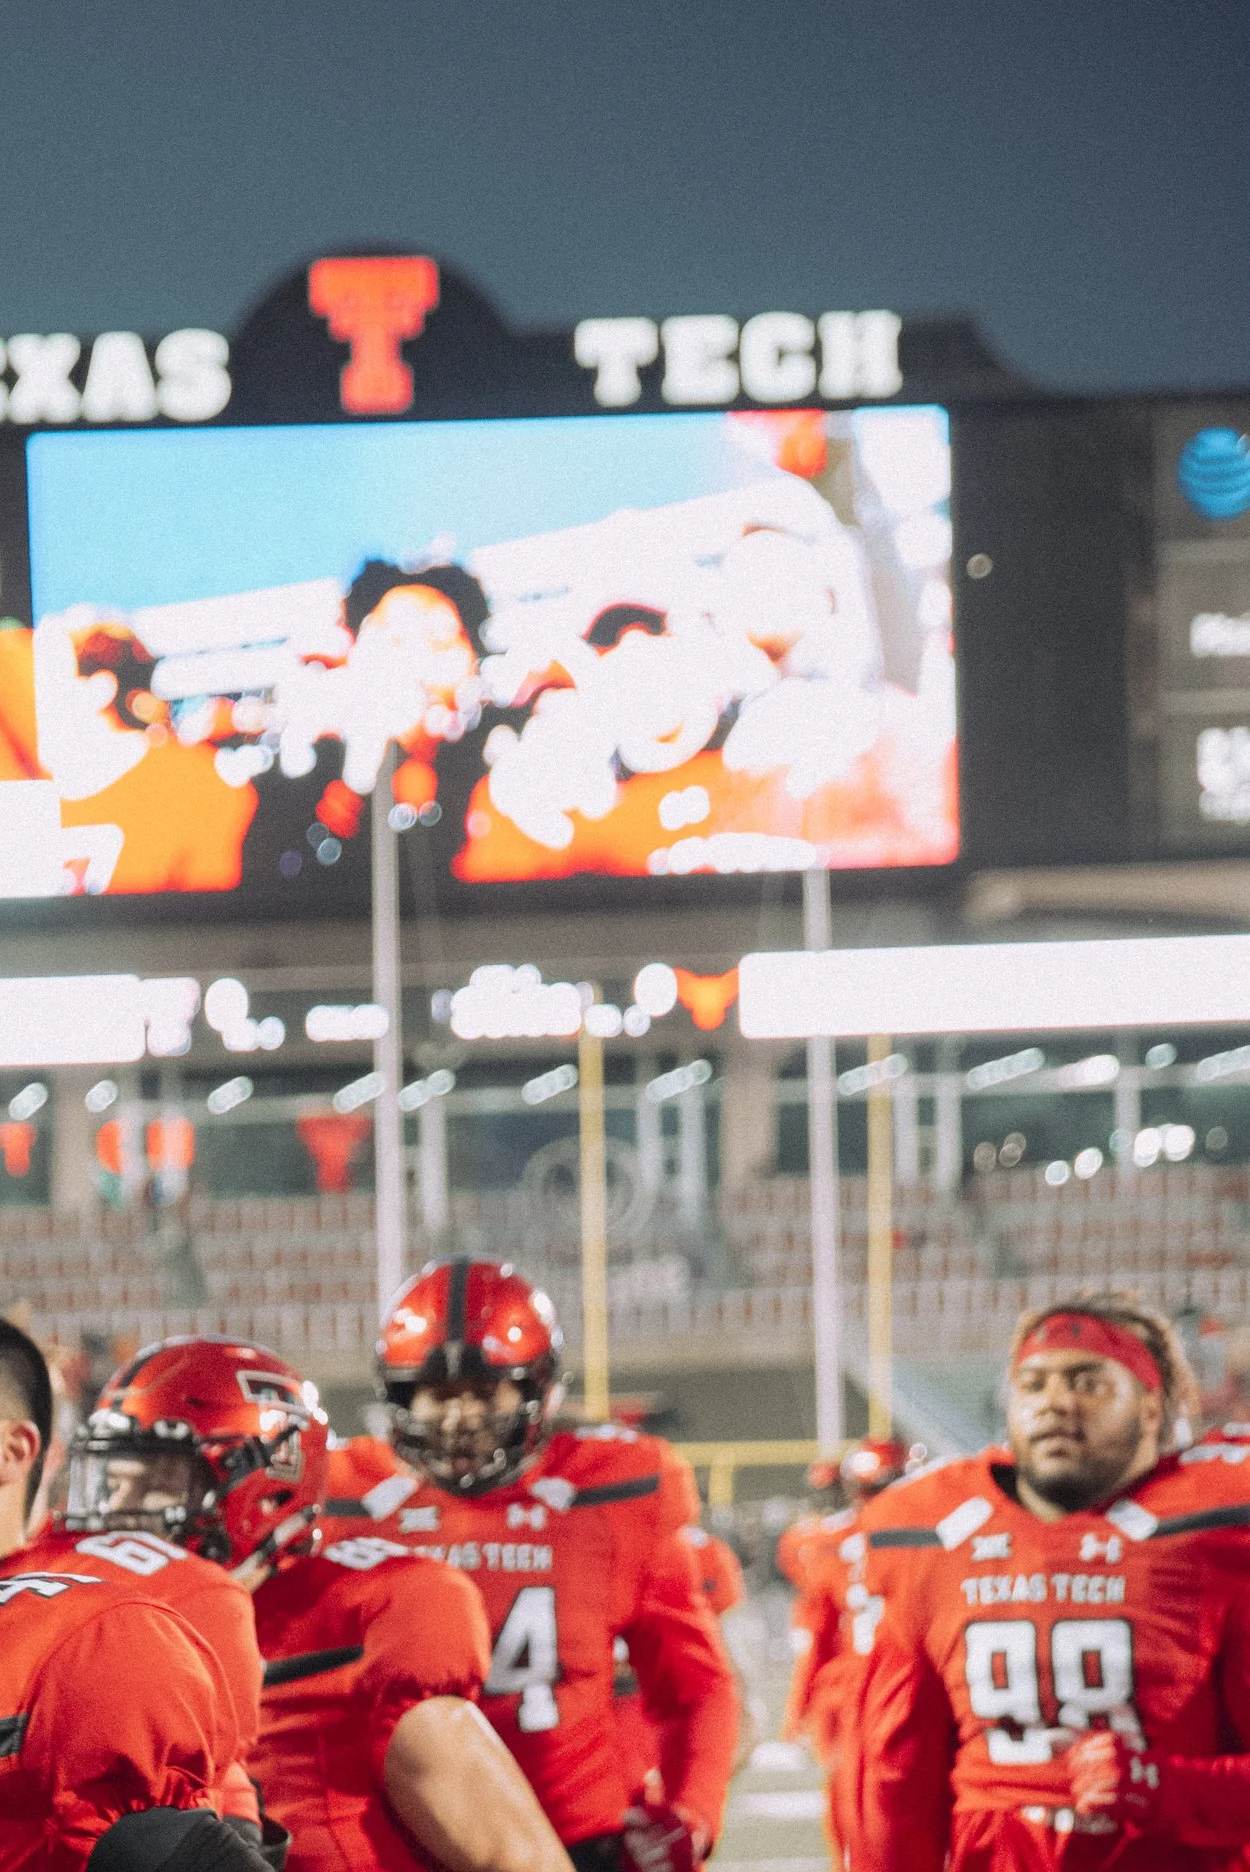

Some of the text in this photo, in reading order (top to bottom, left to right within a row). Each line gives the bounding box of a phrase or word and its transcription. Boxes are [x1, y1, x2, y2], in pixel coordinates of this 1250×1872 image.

[574, 309, 903, 408] TECH
[482, 1543, 553, 1572] TECH
[960, 1573, 1127, 1607] TEXAS TECH
